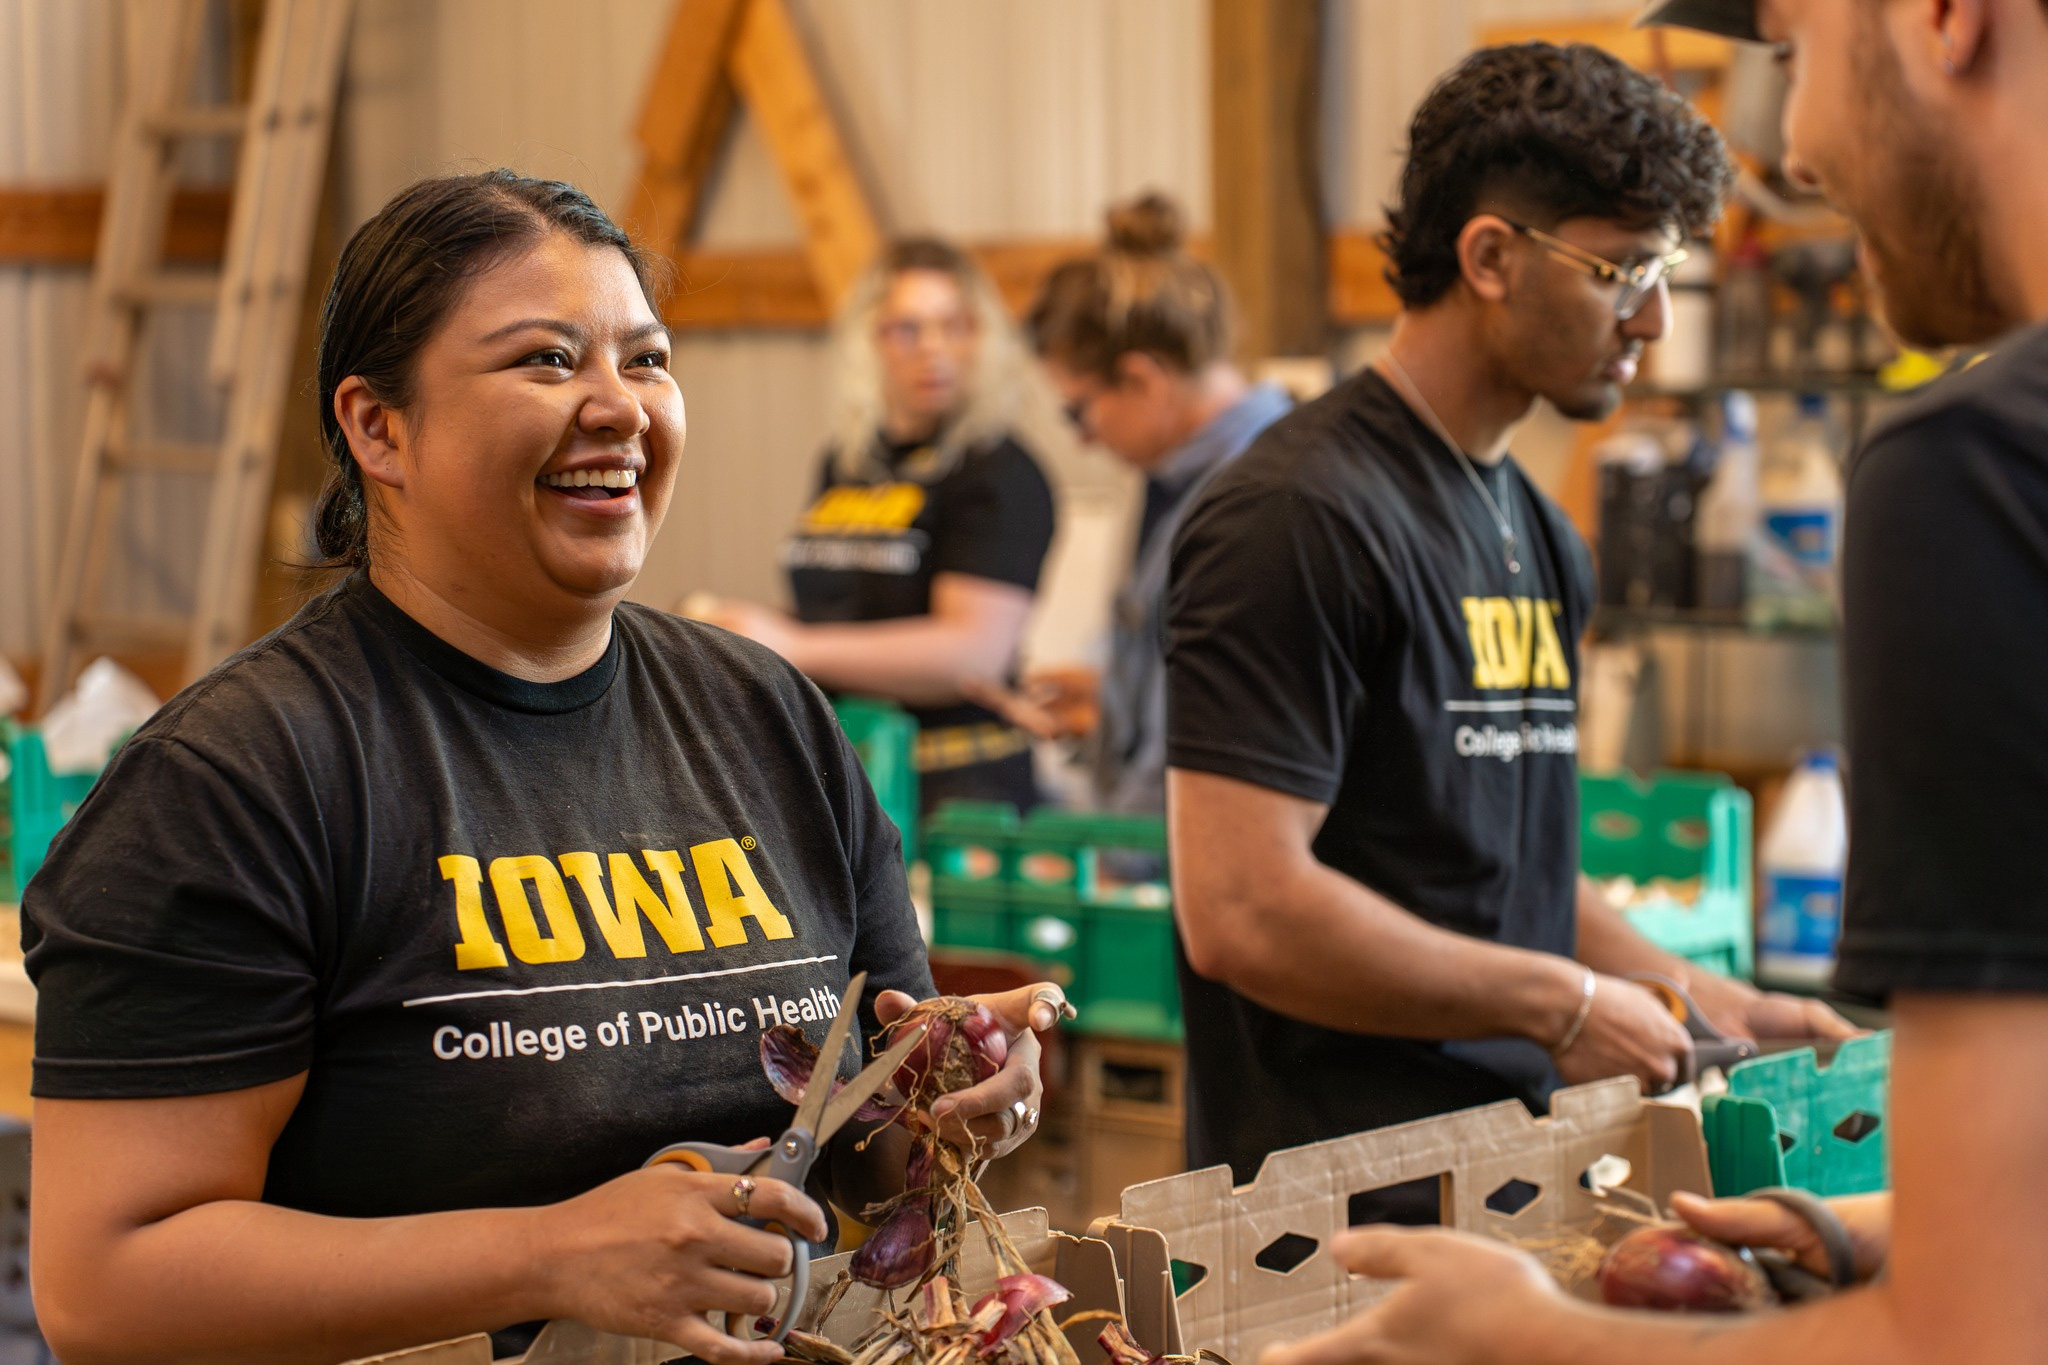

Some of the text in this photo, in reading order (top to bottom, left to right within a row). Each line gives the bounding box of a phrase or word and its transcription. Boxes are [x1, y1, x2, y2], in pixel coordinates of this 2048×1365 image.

[432, 985, 842, 1061] College of Public Health
